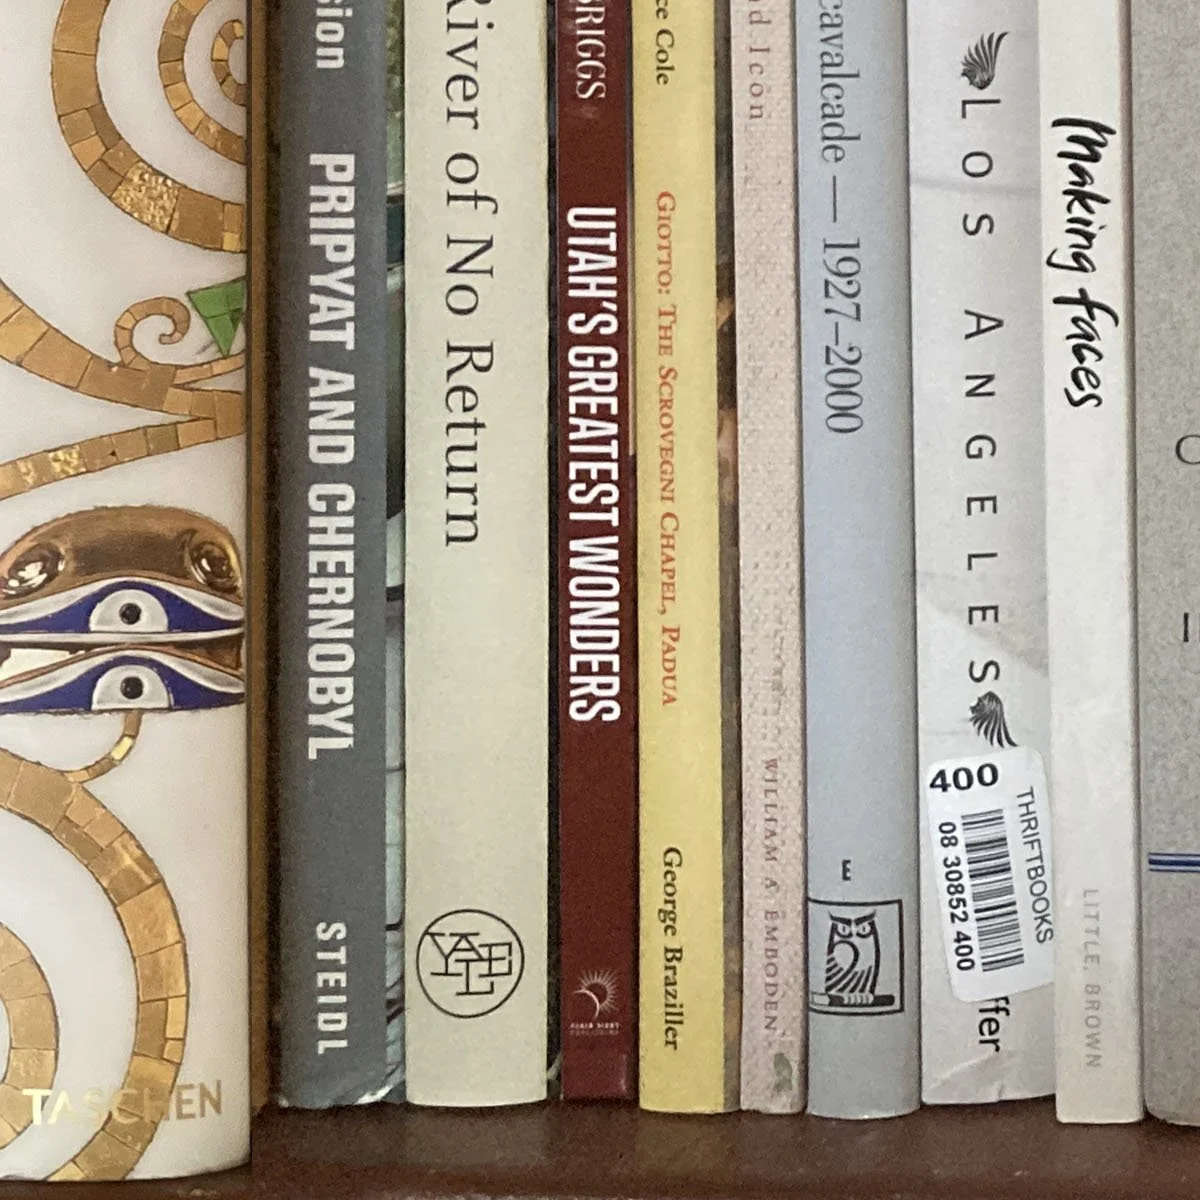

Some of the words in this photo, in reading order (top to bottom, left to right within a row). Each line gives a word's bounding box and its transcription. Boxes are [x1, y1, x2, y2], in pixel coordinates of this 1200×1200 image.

[656, 29, 675, 85] Cole
[749, 46, 771, 121] Icon
[446, 152, 499, 214] of
[961, 99, 1002, 237] LOS
[1046, 117, 1117, 274] Making
[309, 153, 355, 351] PRIPYAT
[446, 234, 495, 316] No
[567, 207, 619, 335] UTAH'S
[308, 367, 355, 464] AND
[445, 341, 495, 547] Return
[567, 345, 620, 527] GREATEST
[964, 308, 1004, 683] ANGELES
[308, 483, 355, 760] CHERNOBYL
[568, 535, 621, 722] WONDERS
[763, 757, 778, 863] WILLIAM
[929, 762, 999, 794] 400
[938, 821, 959, 848] 08
[1016, 786, 1054, 945] THRIFTBOOKS
[658, 847, 683, 937] George
[942, 855, 969, 924] 30852
[315, 922, 348, 1055] STEIDL
[663, 946, 684, 1051] Braziller
[764, 910, 778, 1032] EMBODEN
[952, 931, 976, 971] 400
[1085, 983, 1101, 1068] BROWN
[22, 1079, 222, 1126] TASCHEN
